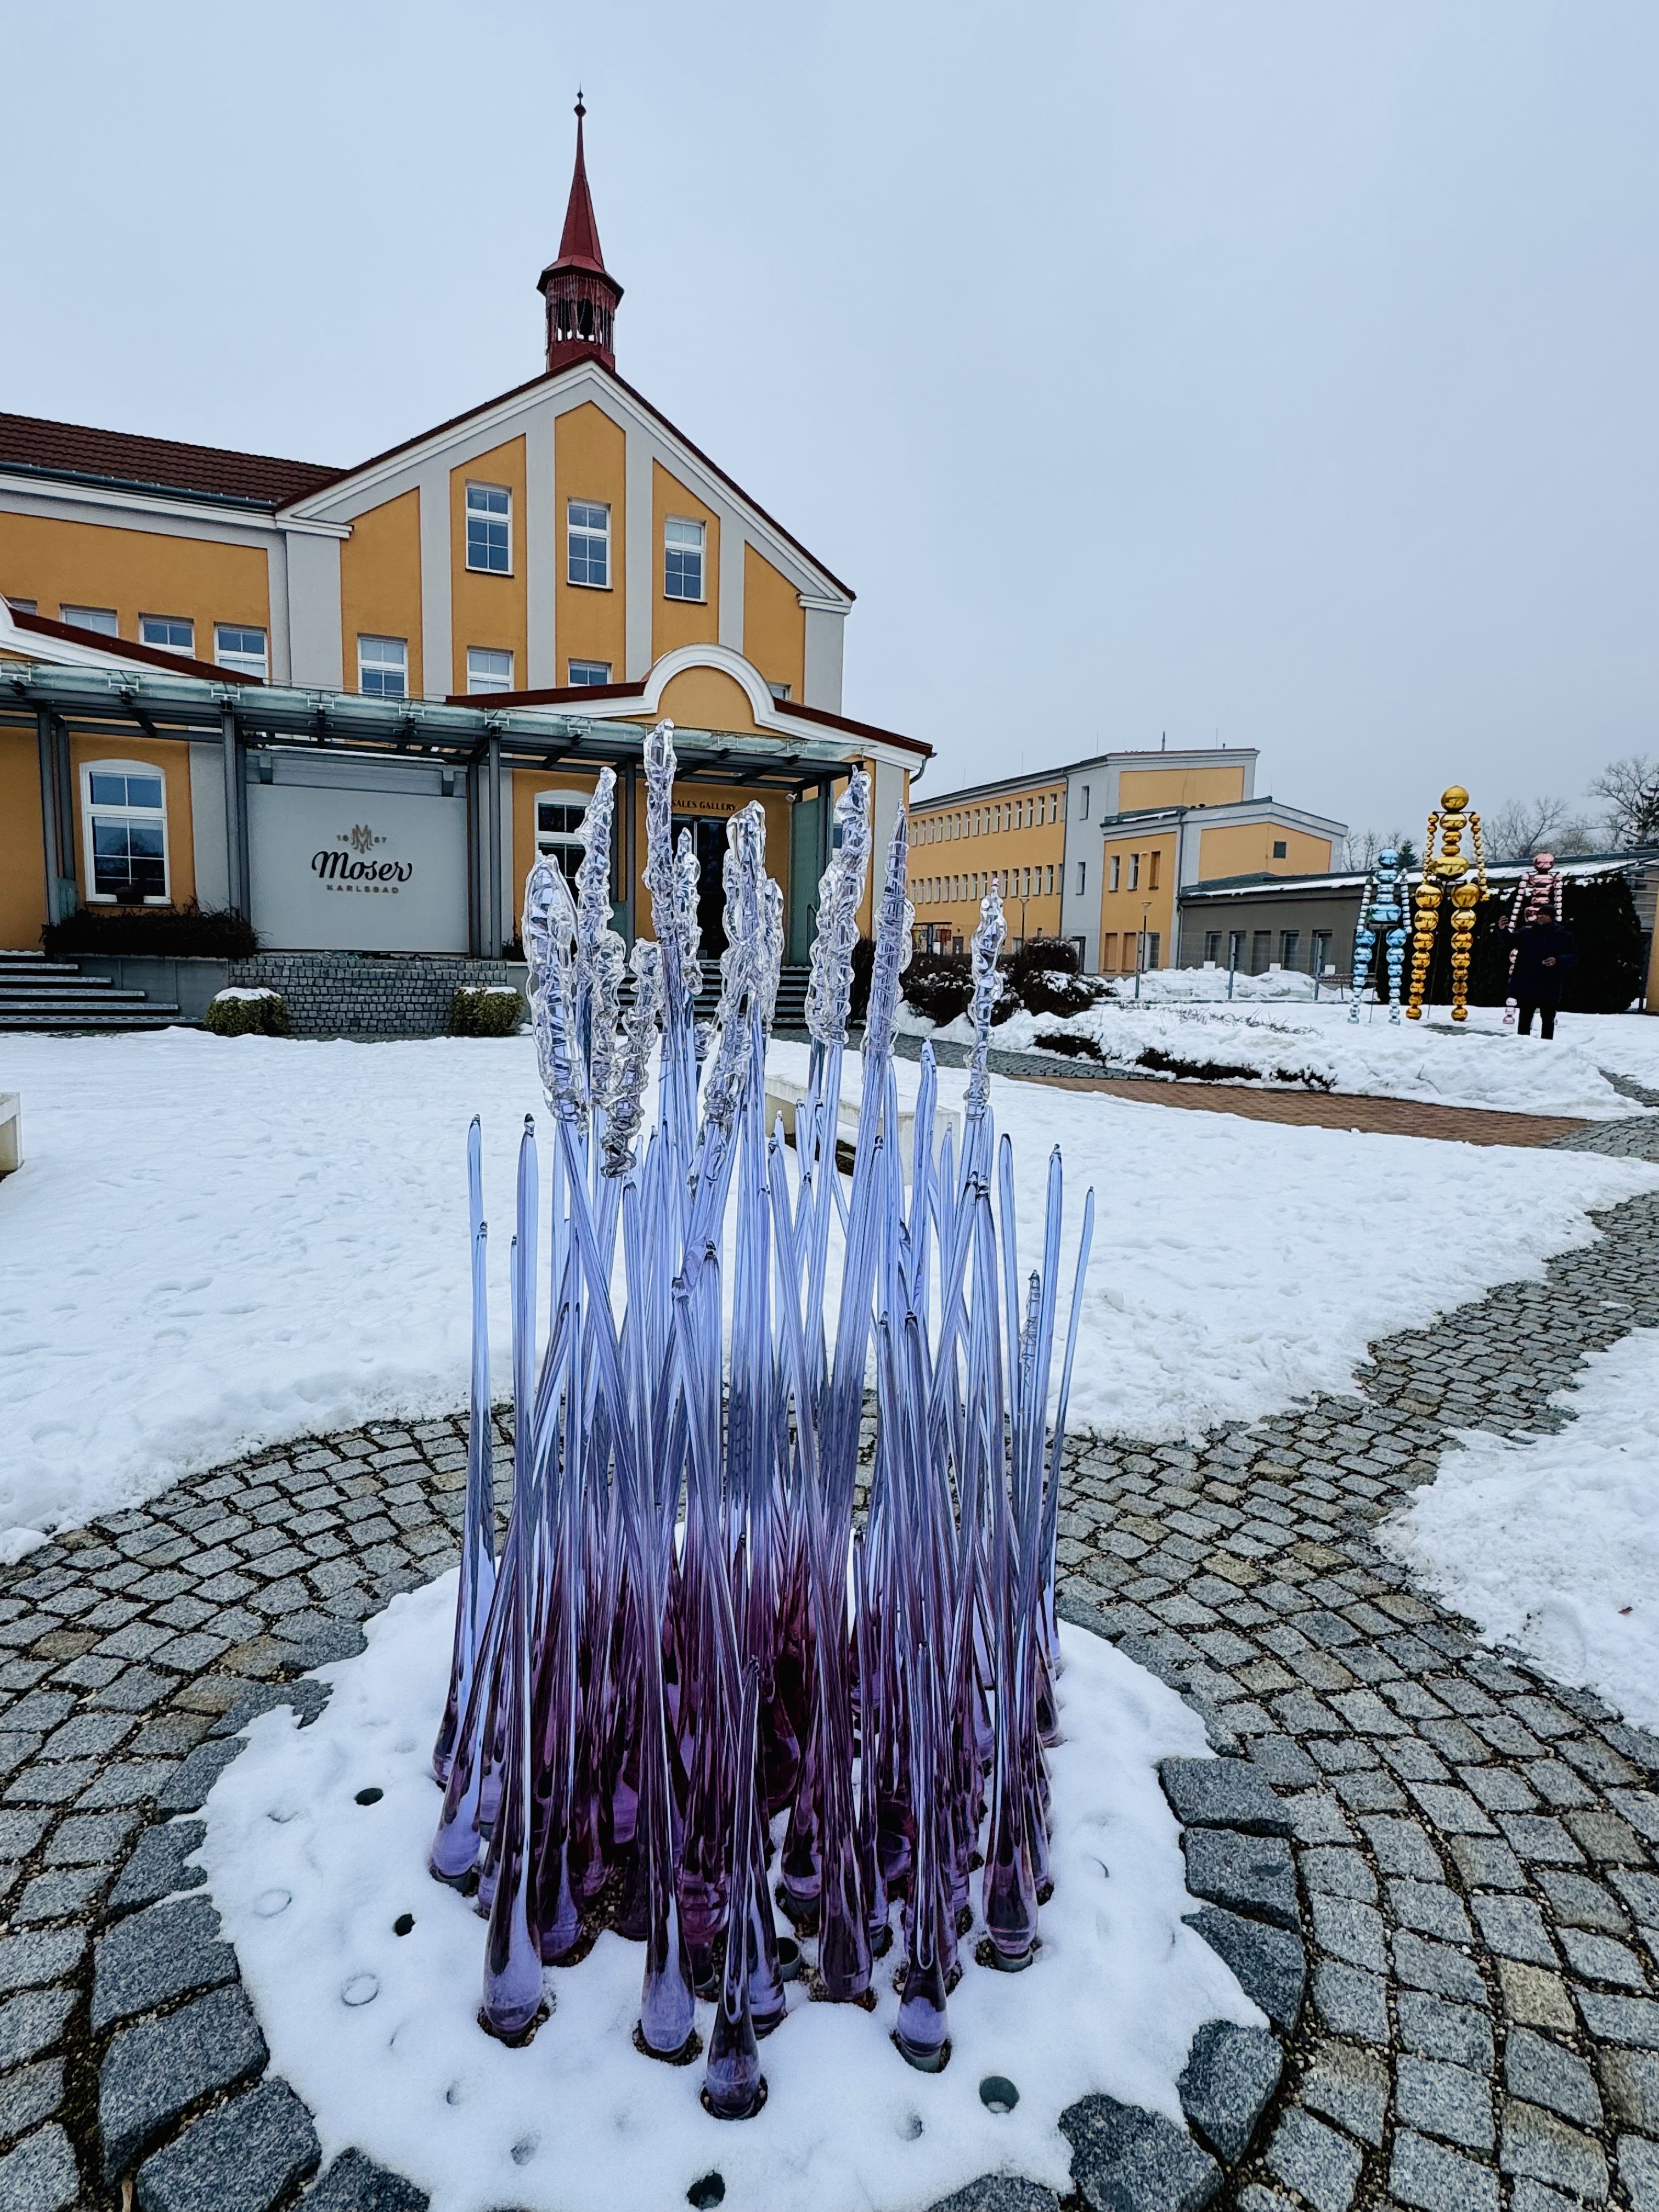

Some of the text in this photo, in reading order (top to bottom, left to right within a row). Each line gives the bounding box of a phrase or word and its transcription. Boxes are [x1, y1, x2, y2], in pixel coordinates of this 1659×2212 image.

[672, 800, 735, 811] SALES GALLERY
[312, 851, 413, 882] Moser
[326, 884, 399, 894] KARLSBAD
